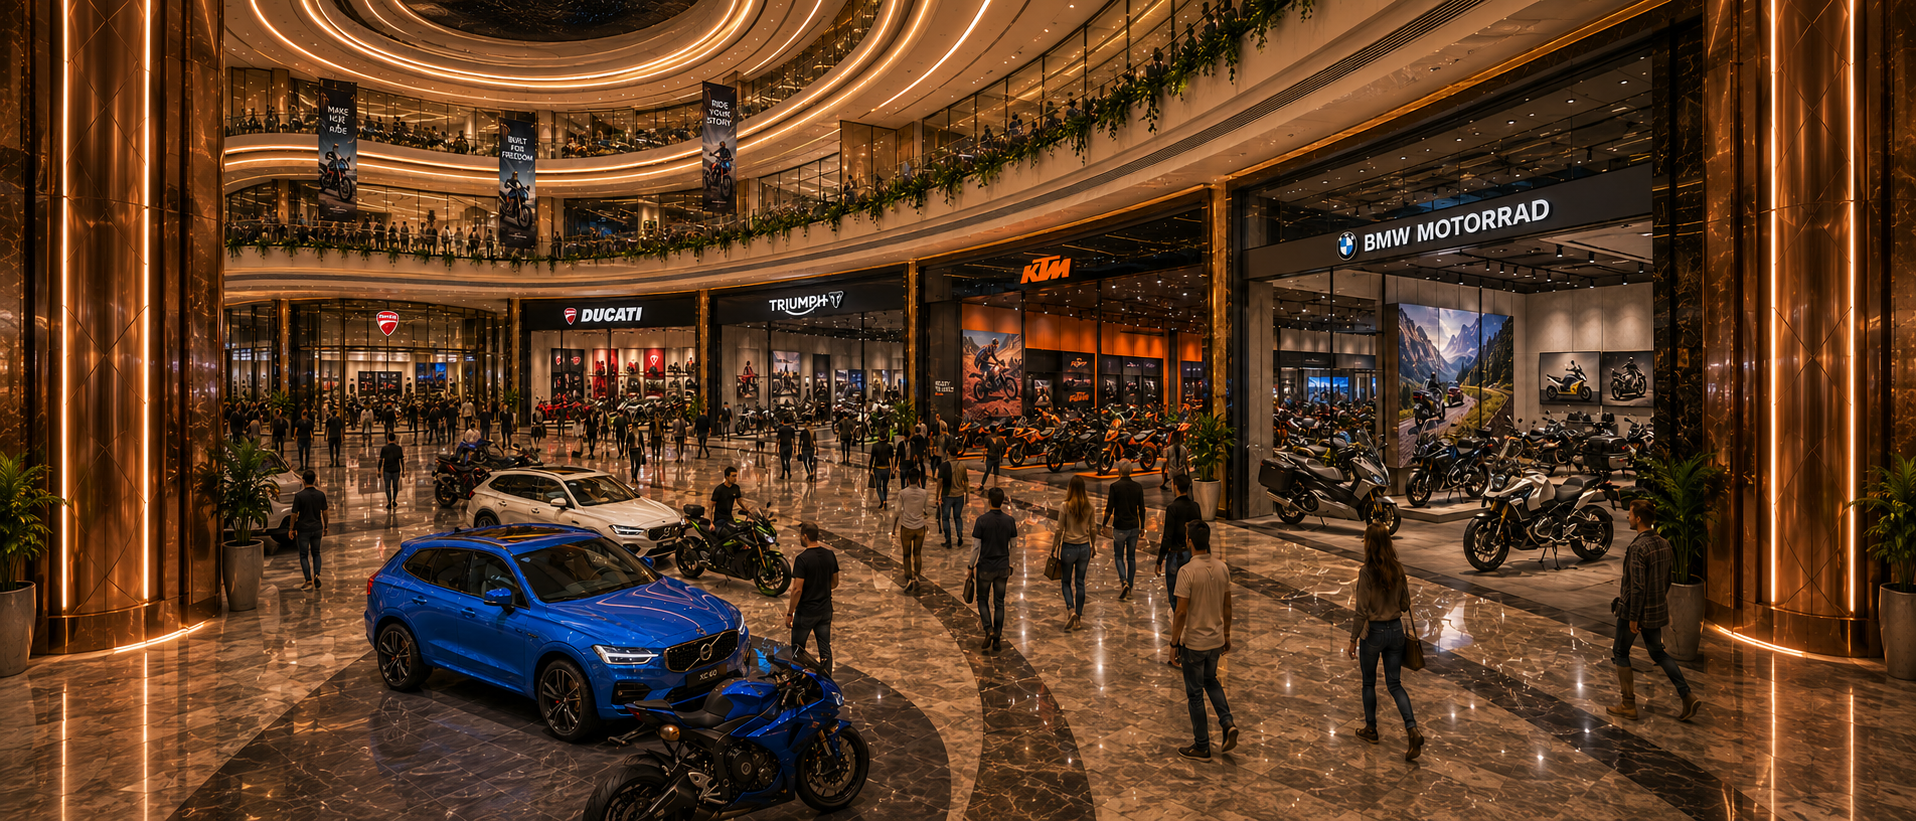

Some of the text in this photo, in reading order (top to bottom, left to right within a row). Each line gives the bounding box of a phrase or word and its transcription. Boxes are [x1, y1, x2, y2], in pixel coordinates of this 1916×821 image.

[712, 99, 729, 110] RIDE
[707, 116, 732, 127] STORY
[1364, 199, 1550, 252] BMW MOTORRAD
[1020, 255, 1071, 284] KTM
[769, 294, 829, 315] TRIUMPH
[581, 307, 642, 322] DUCATI
